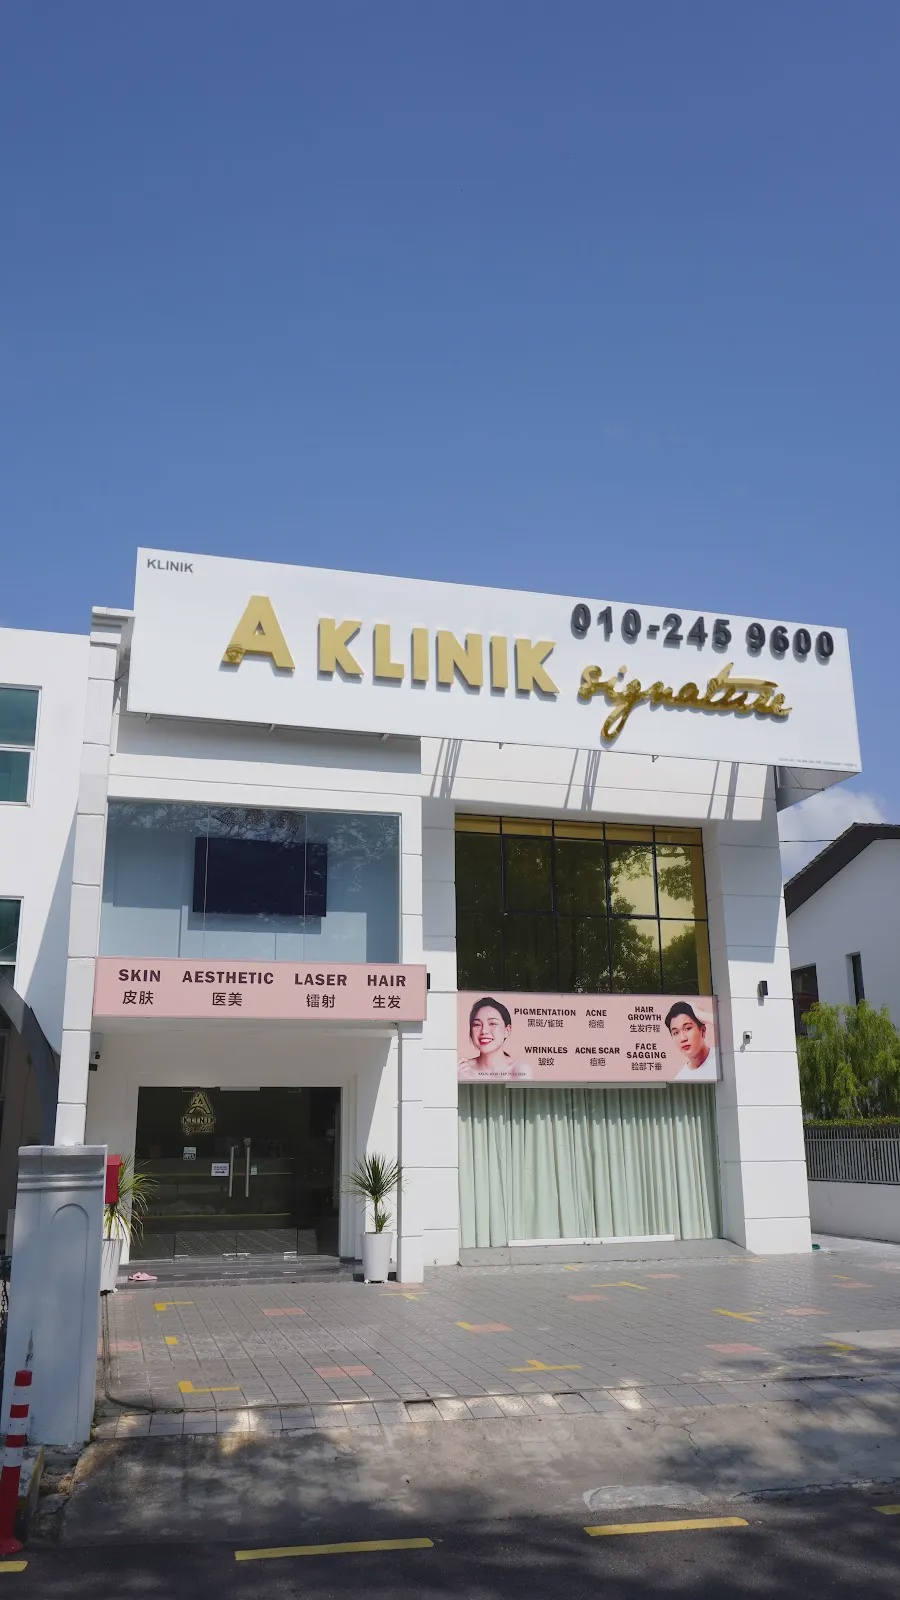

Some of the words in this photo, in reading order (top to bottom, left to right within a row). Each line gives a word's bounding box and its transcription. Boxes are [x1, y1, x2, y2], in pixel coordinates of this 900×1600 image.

[147, 558, 194, 573] KLINIK
[571, 603, 733, 650] 010-245
[746, 622, 835, 663] 9600
[221, 594, 296, 671] A
[318, 617, 560, 695] KLINIK
[118, 968, 161, 983] SKIN
[182, 970, 274, 985] AESTHETIC
[294, 973, 348, 986] LASER
[367, 974, 406, 987] HAIR
[122, 990, 154, 1005] 皮肤
[212, 992, 243, 1007] 医美
[306, 994, 336, 1009] 镭射
[372, 995, 402, 1009] 生发
[513, 1007, 577, 1017] PIGMENTATION
[585, 1009, 607, 1018] ACNE
[634, 1005, 654, 1014] HAIR
[627, 1013, 662, 1022] GROWTH
[524, 1046, 568, 1055] WRINKLES
[574, 1046, 597, 1055] ACNE
[598, 1046, 621, 1055] SCAR
[635, 1042, 658, 1051] FACE
[626, 1051, 667, 1060] SAGGING
